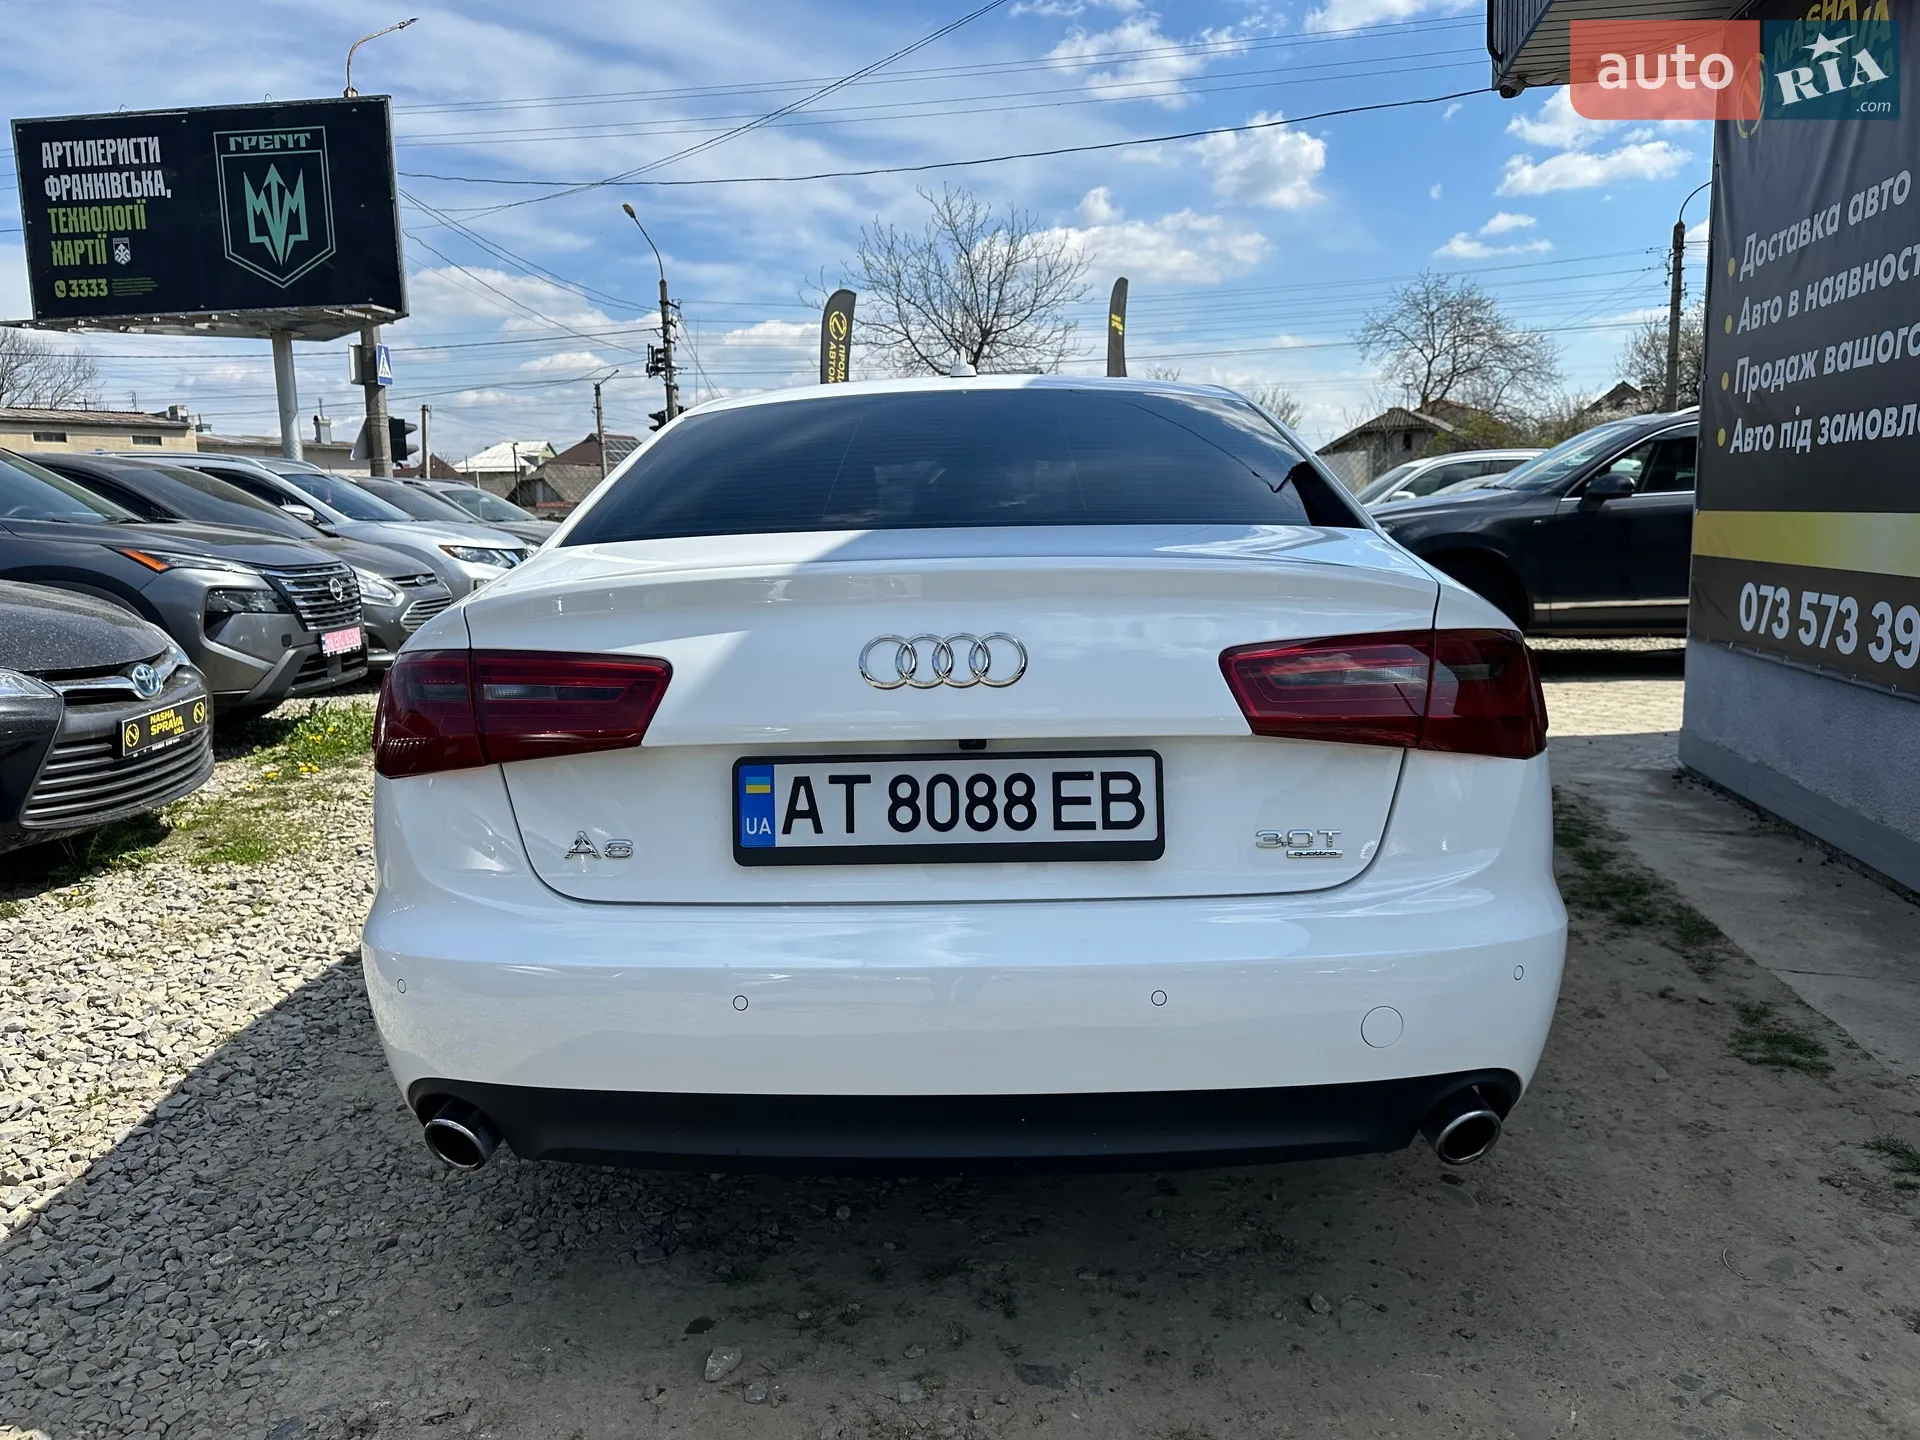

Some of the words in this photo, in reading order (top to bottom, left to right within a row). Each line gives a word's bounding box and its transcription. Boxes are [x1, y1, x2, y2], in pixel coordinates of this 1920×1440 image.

[42, 136, 161, 168] АРТИЛЕРИСТИ
[44, 170, 172, 201] ФРАНКІВСЬКА,
[47, 199, 147, 234] ТЕХНОЛОГІЇ
[1739, 202, 1842, 281] Доставка
[1848, 169, 1911, 226] авто
[51, 233, 107, 266] ХАРТІЇ
[69, 279, 108, 298] 3333
[1736, 296, 1783, 335] Авто
[1787, 289, 1800, 318] в
[837, 343, 846, 383] ПРОД
[1734, 350, 1819, 403] Продаж
[1729, 417, 1774, 454] Авто
[1779, 405, 1812, 454] під
[1817, 403, 1920, 446] замовл
[1739, 581, 1791, 640] 073
[1797, 590, 1859, 655] 573
[1867, 601, 1920, 669] 39
[149, 709, 175, 725] NASHA
[150, 715, 184, 736] SPRAVA
[173, 725, 185, 735] USA
[746, 818, 772, 835] UA
[782, 775, 871, 835] AT
[887, 773, 1037, 833] 8088
[1052, 770, 1145, 831] EB
[564, 830, 634, 860] A6
[1294, 850, 1337, 859] quattro
